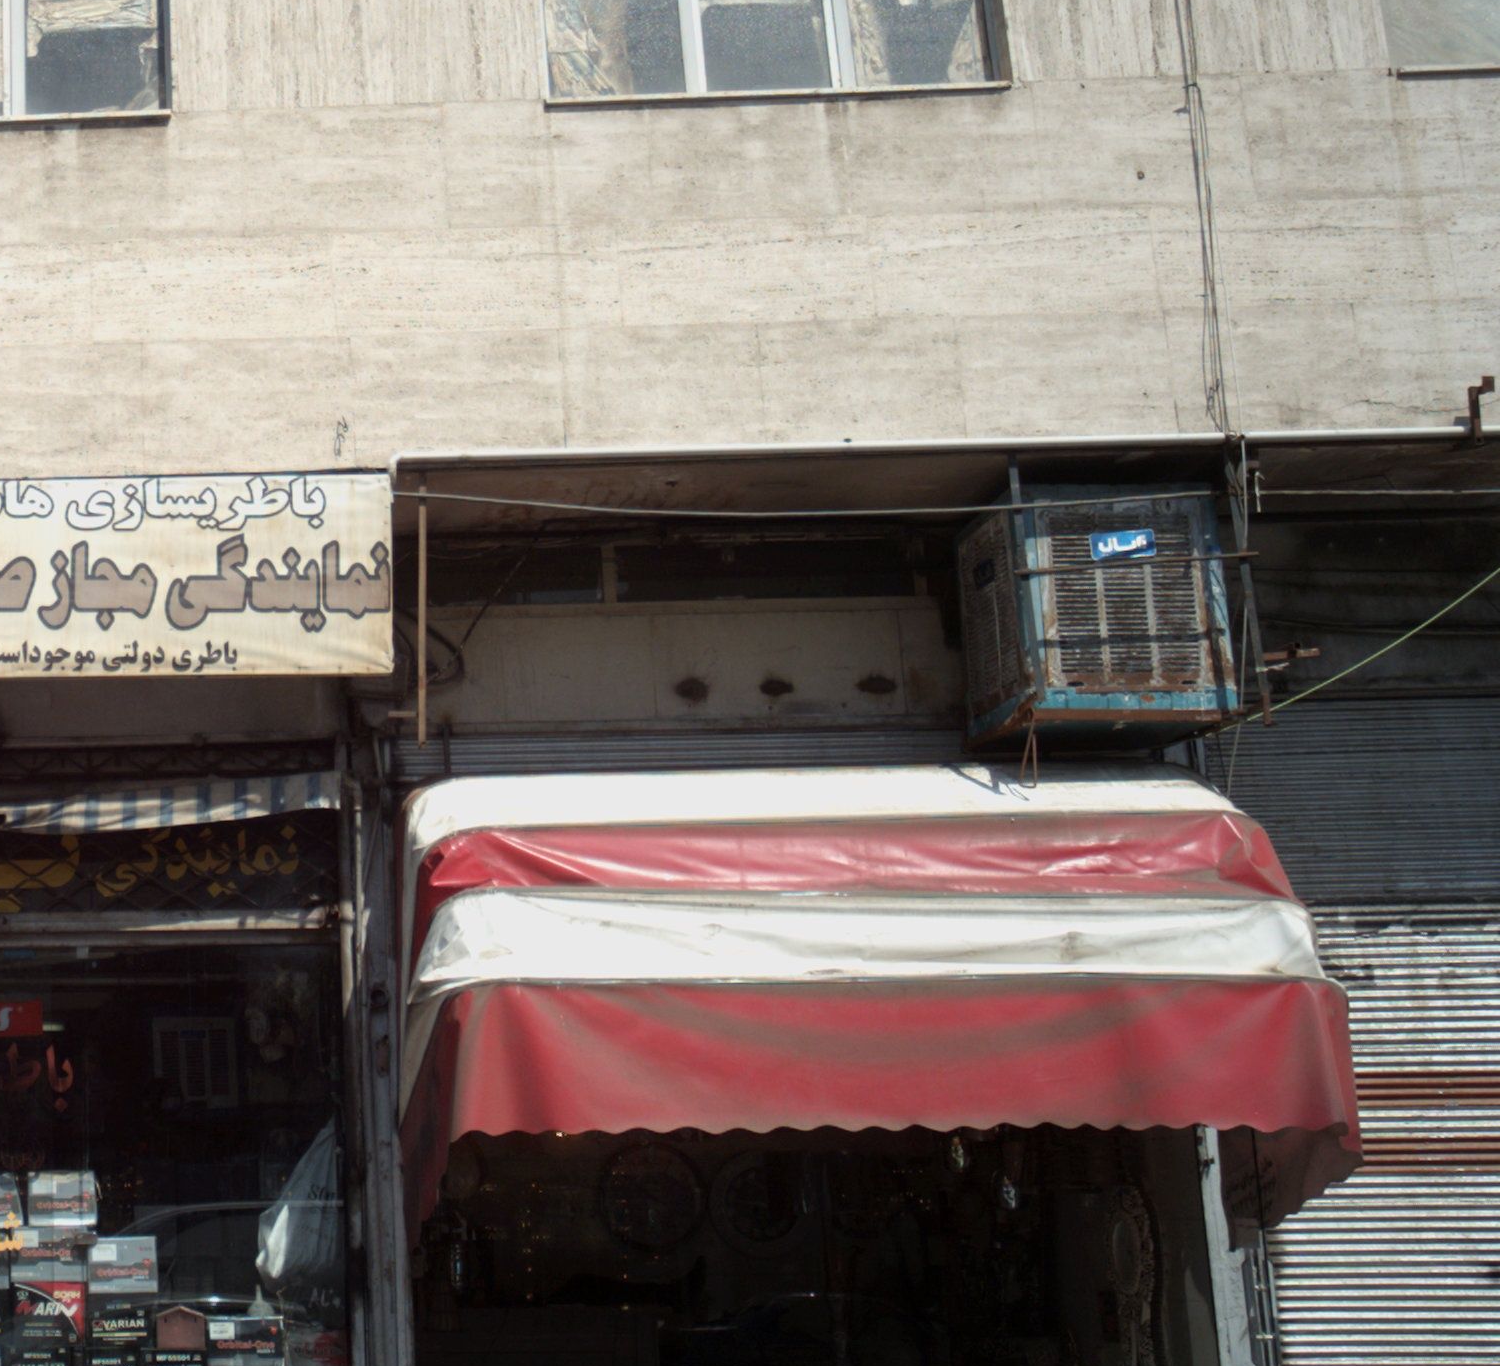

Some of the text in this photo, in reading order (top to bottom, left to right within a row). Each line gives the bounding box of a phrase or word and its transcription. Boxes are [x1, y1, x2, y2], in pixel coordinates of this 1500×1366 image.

[37, 537, 158, 630] مجاز
[165, 533, 391, 633] نمایندگی
[101, 640, 165, 672] دولتی
[171, 640, 239, 672] باطری
[102, 1316, 145, 1329] VARIAN
